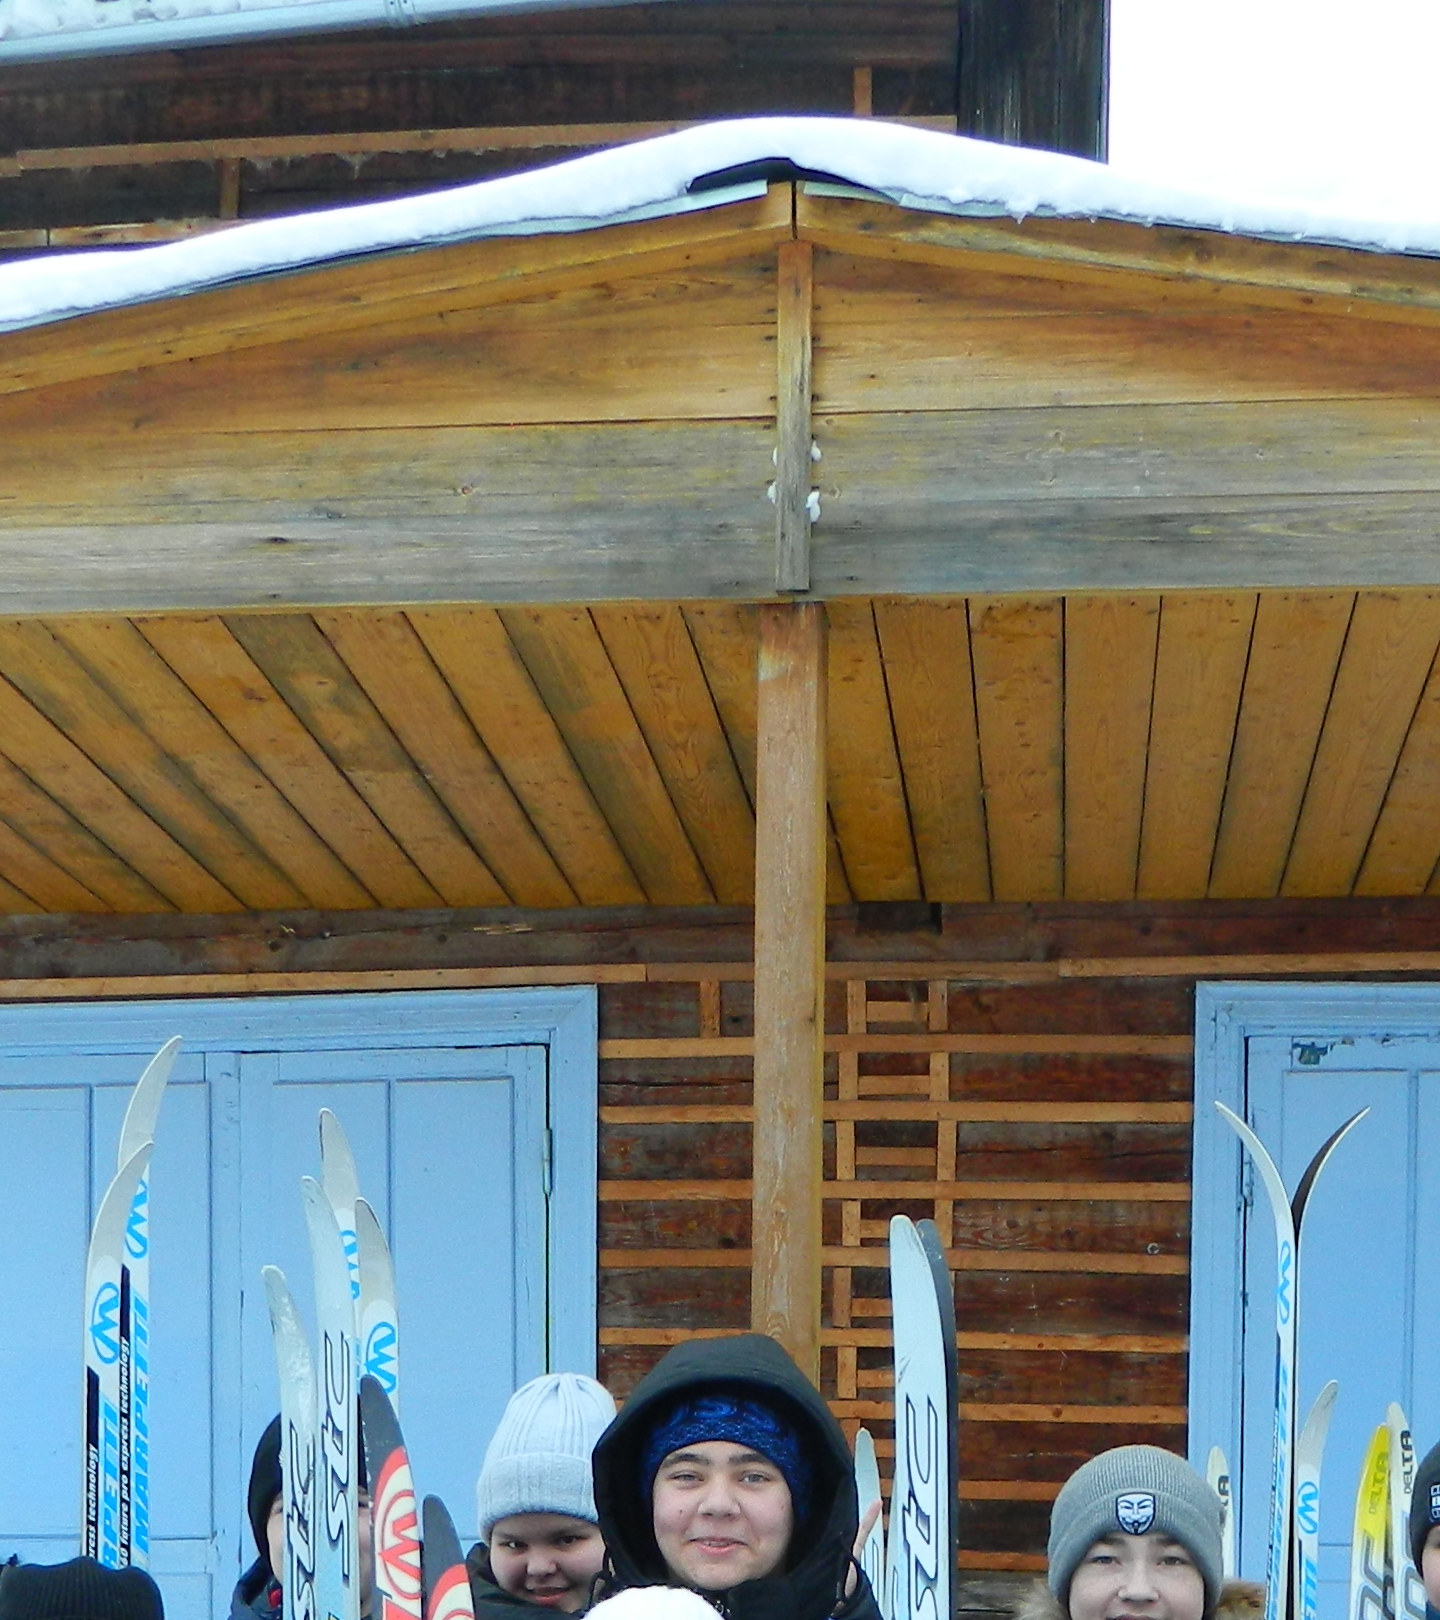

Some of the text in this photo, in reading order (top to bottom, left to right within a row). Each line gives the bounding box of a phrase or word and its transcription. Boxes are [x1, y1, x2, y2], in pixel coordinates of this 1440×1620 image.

[119, 1336, 130, 1414] technology
[119, 1417, 130, 1471] express
[133, 1288, 148, 1554] MARPETTI
[86, 1442, 98, 1522] technology
[120, 1474, 130, 1502] pro
[1400, 1430, 1412, 1495] DELTA
[120, 1504, 129, 1545] future
